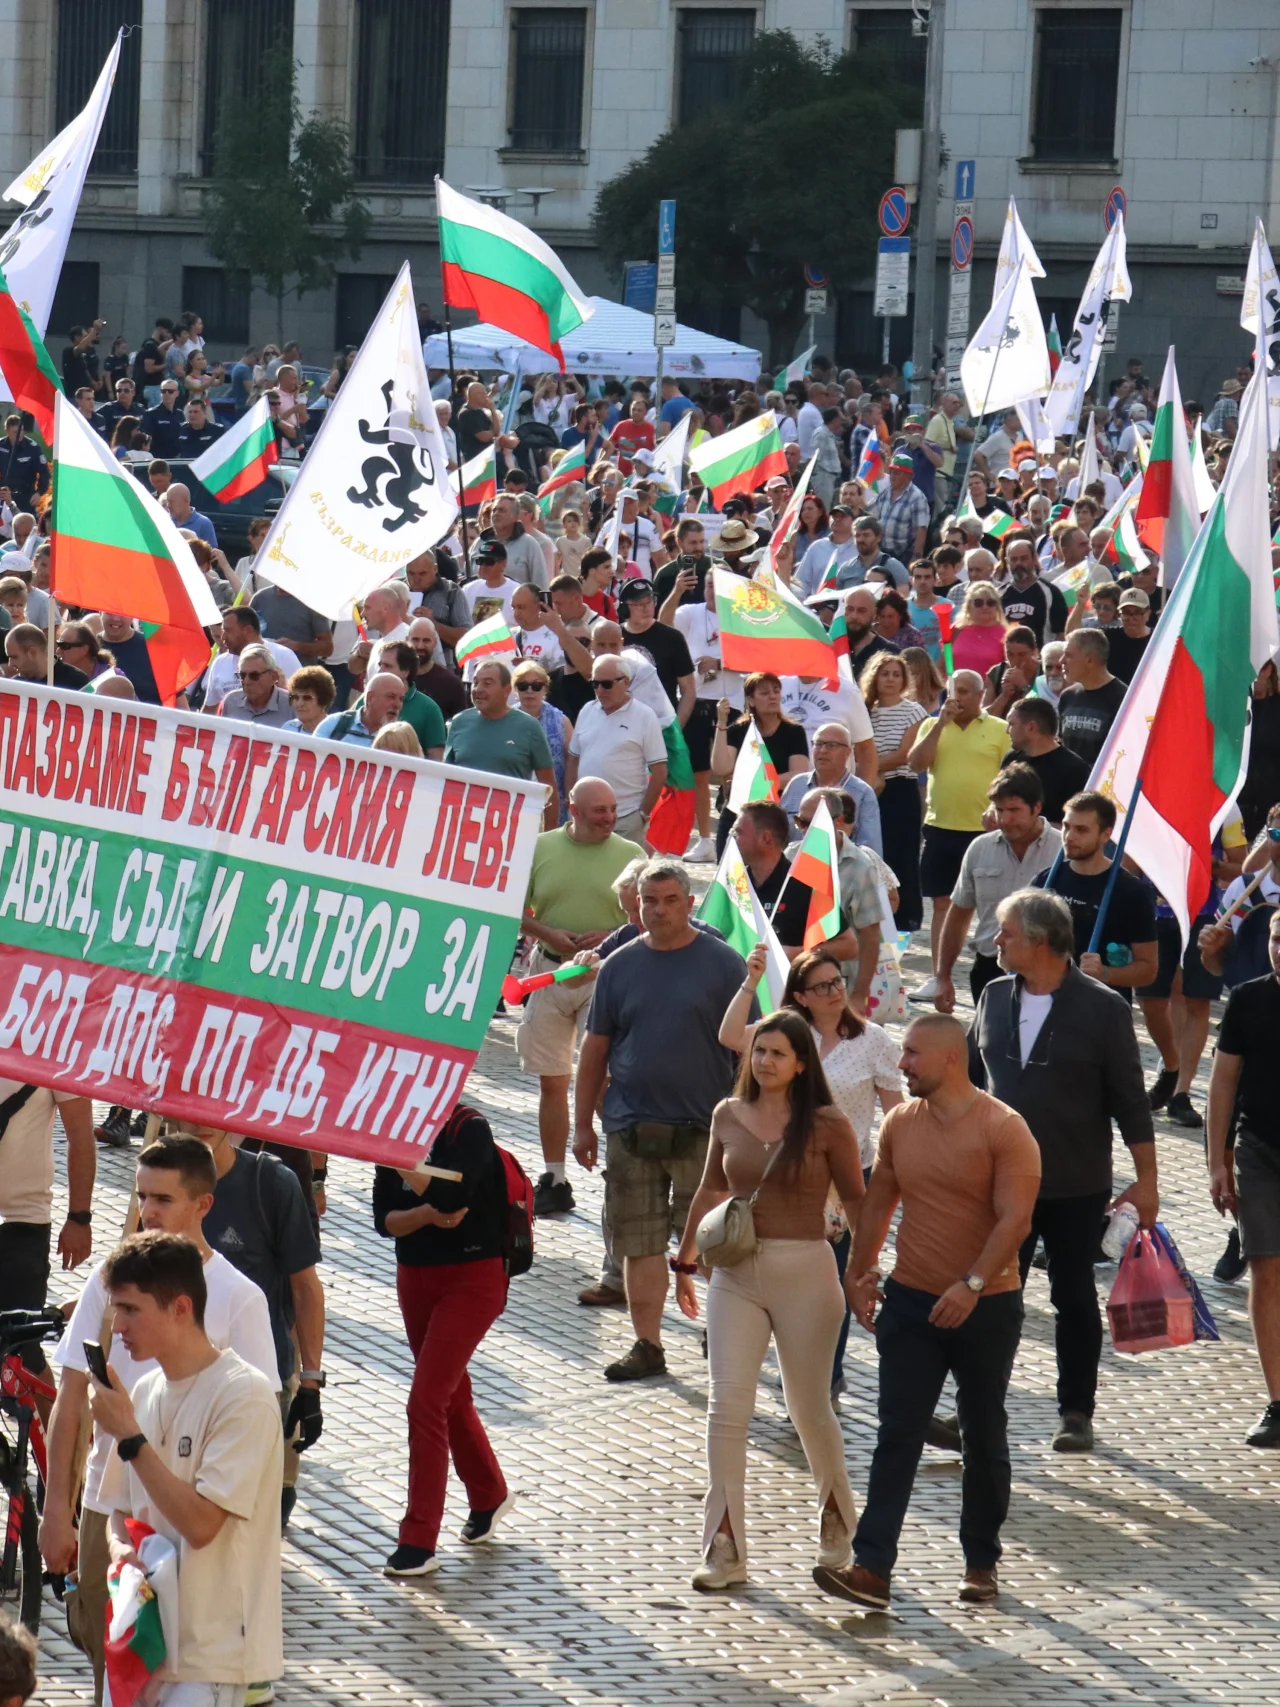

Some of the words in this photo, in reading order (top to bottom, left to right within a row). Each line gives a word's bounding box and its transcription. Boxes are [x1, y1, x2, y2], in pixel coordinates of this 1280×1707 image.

[1005, 603, 1035, 616] FUBU
[799, 692, 831, 712] TAILOR
[162, 725, 416, 868] БЪЛГАРСКИЯ
[422, 779, 525, 893] ЛЕВ!
[111, 848, 197, 973] СЪД
[193, 866, 244, 963] И
[249, 878, 421, 1001] ЗАТВОР
[424, 917, 491, 1022] ЗА
[75, 984, 176, 1102] ДПС,
[181, 1004, 263, 1120] ПП,
[247, 1024, 341, 1136] ДБ,
[335, 1042, 464, 1146] ИТН!
